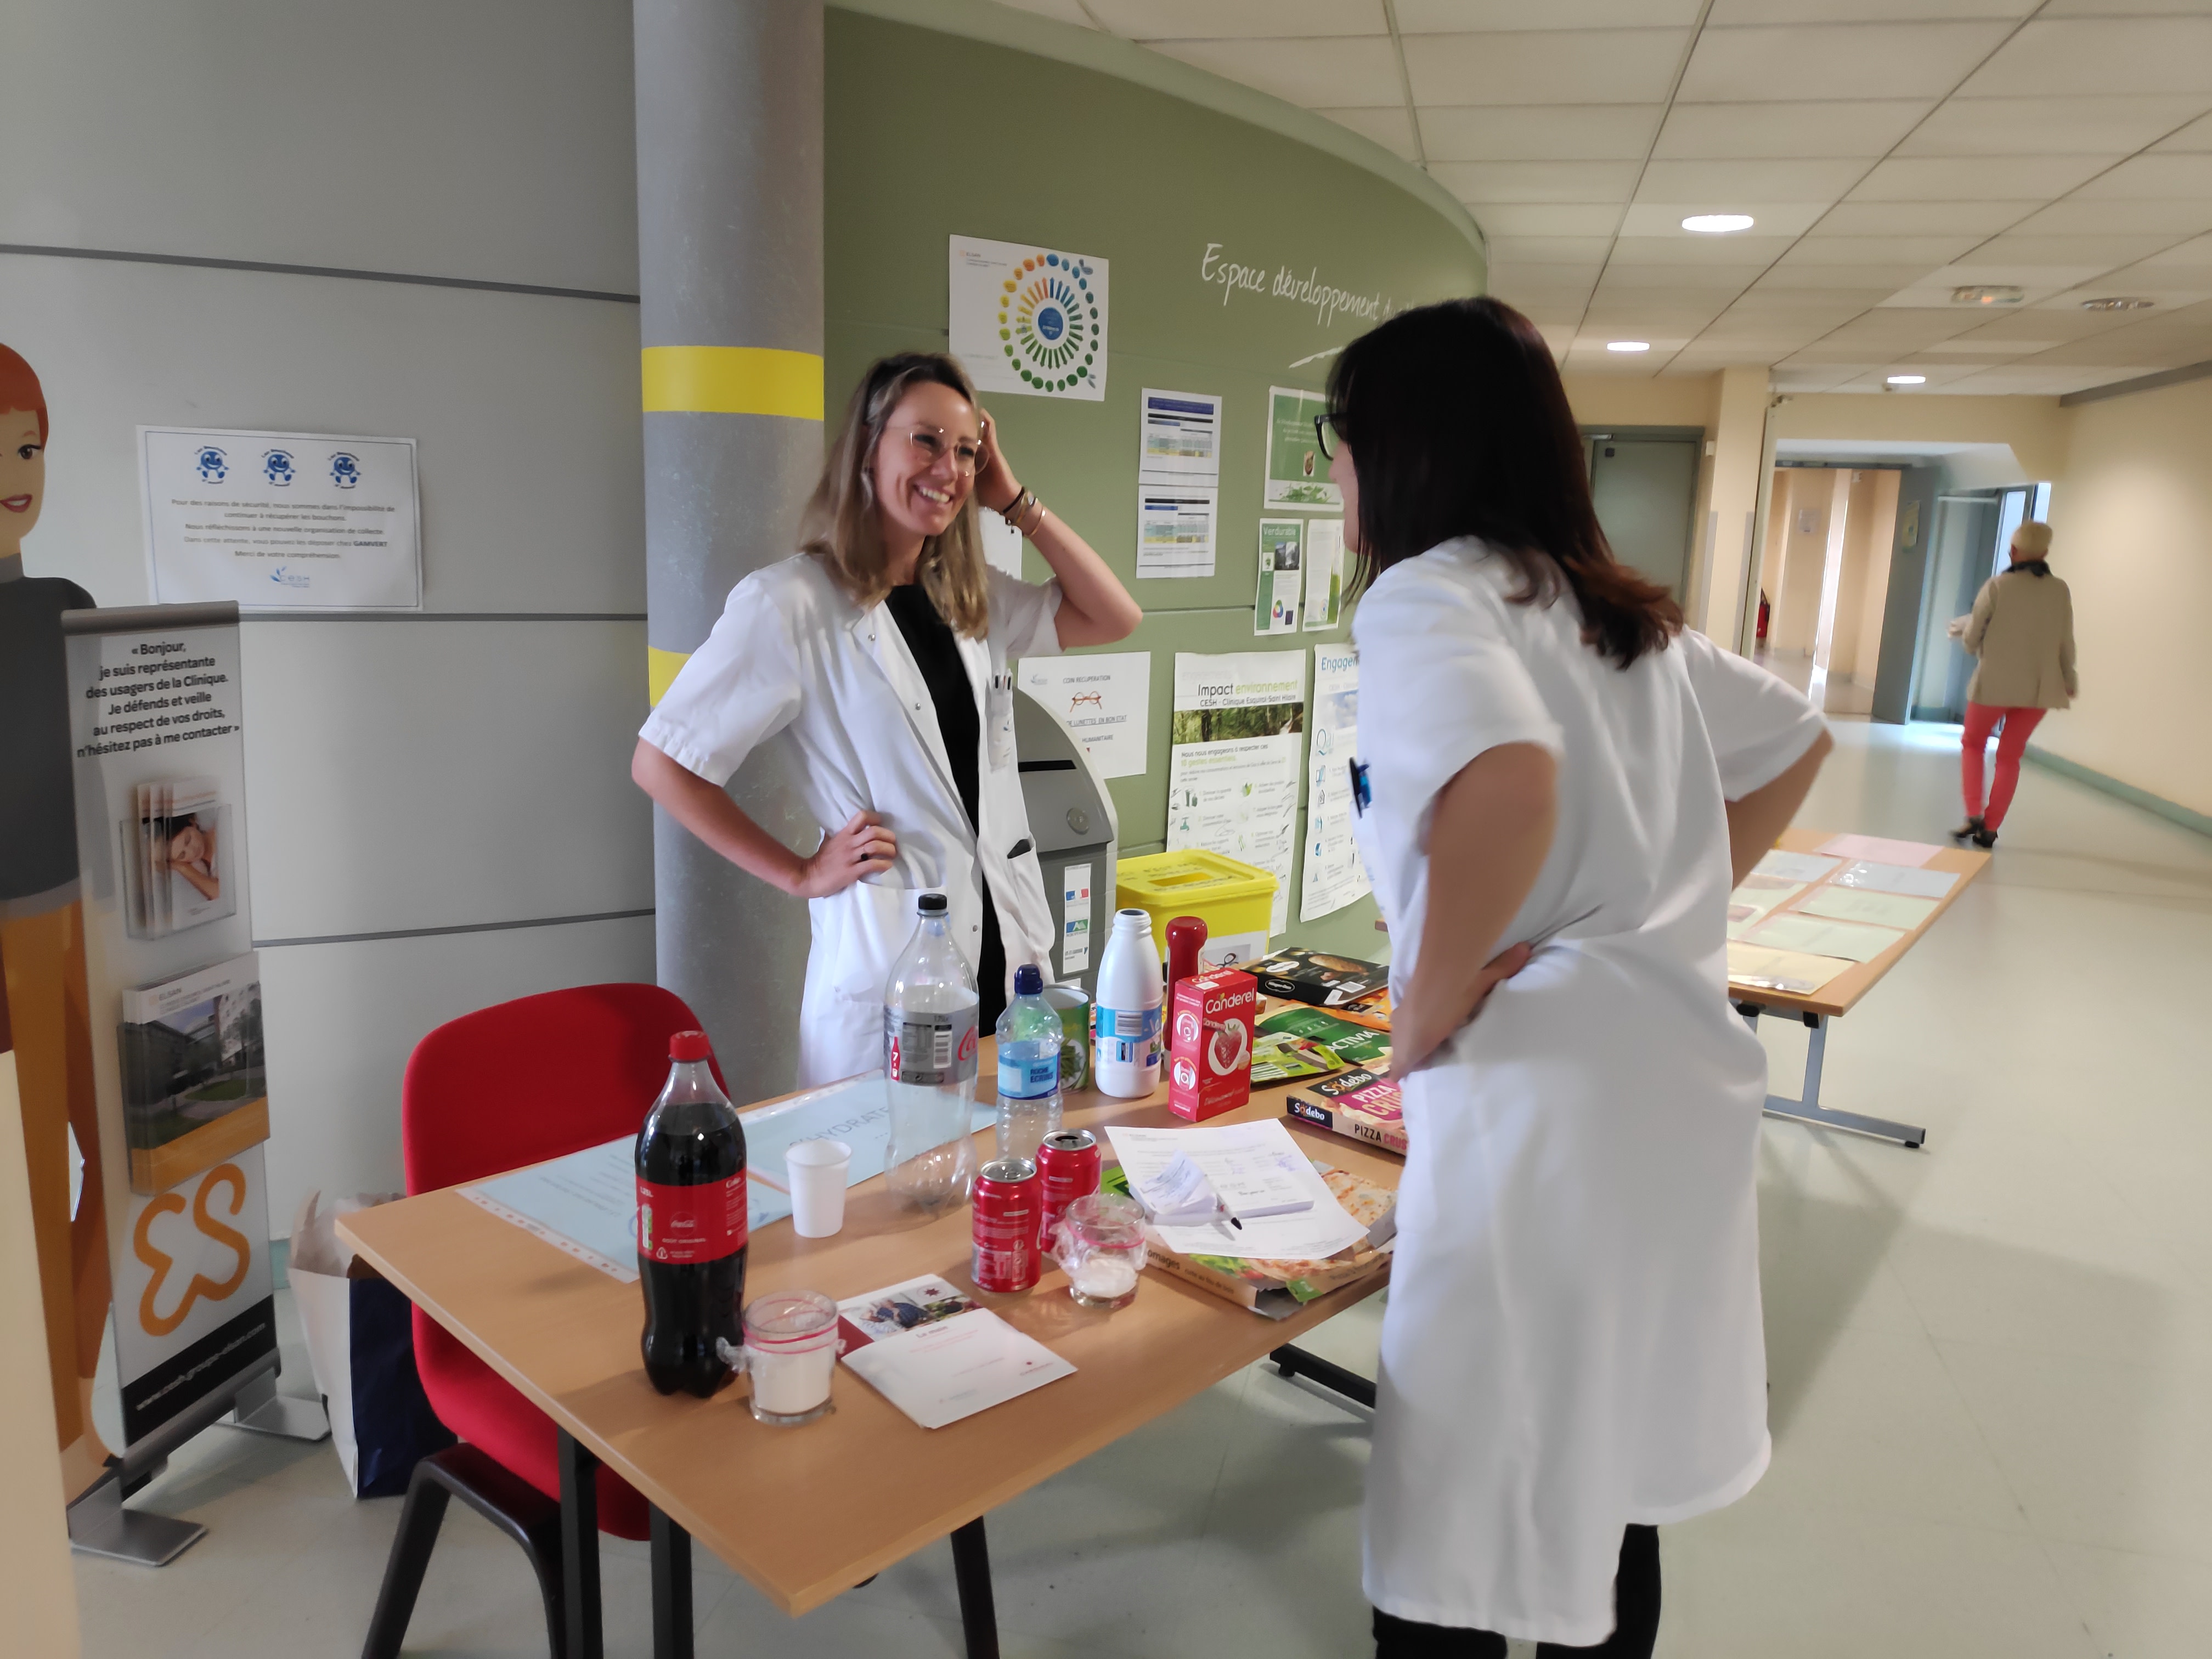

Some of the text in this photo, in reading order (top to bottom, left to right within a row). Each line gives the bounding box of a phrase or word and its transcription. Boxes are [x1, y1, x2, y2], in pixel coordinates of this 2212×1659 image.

[1201, 243, 1265, 306] Espace
[1272, 266, 1380, 328] développement
[140, 641, 186, 656] Bonjour,
[99, 656, 215, 681] je suis représentante
[1322, 656, 1356, 673] Engage
[86, 673, 228, 698] des usagers de la Clinique.
[1198, 680, 1298, 698] Impact environnement
[108, 692, 211, 715] Je défends et veille
[1222, 697, 1245, 706] Clinique
[93, 708, 225, 736] au respect de vos droits,
[133, 738, 153, 752] pas
[155, 734, 161, 745] à
[164, 733, 180, 743] me
[182, 723, 233, 741] contacter
[1208, 747, 1234, 756] engageons
[1205, 988, 1255, 1014] Canderel
[893, 1051, 899, 1062] 7
[1321, 1073, 1372, 1096] Sodebo
[1351, 1085, 1397, 1103] PIZZA
[1294, 1102, 1325, 1121] Sodebo
[1362, 1092, 1402, 1116] CRU
[1355, 1124, 1408, 1150] PIZZA CRUS
[1147, 1249, 1180, 1270] omages
